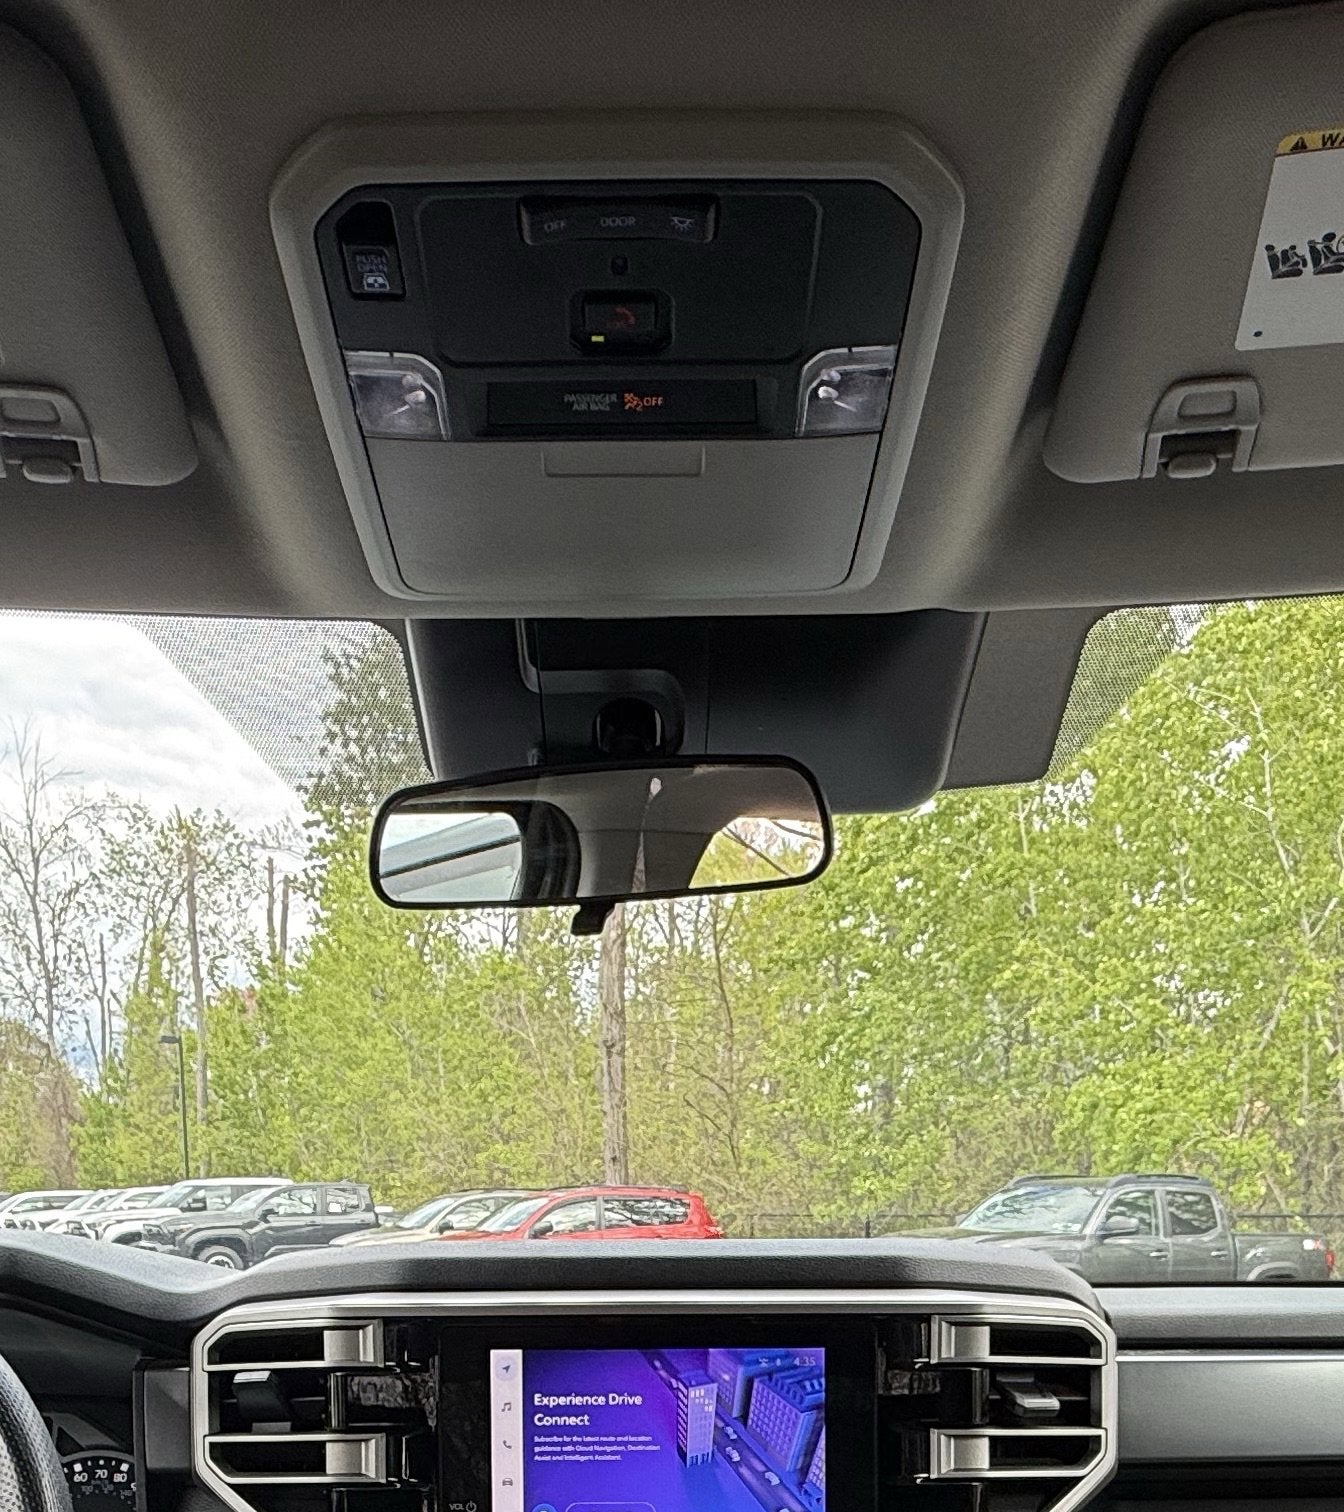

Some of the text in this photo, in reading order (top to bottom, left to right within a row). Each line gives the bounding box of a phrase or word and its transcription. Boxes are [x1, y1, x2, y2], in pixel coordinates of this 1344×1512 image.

[643, 396, 664, 407] OFF
[534, 1392, 643, 1408] Experience Drive
[534, 1413, 591, 1427] Connect
[95, 1469, 108, 1479] 70
